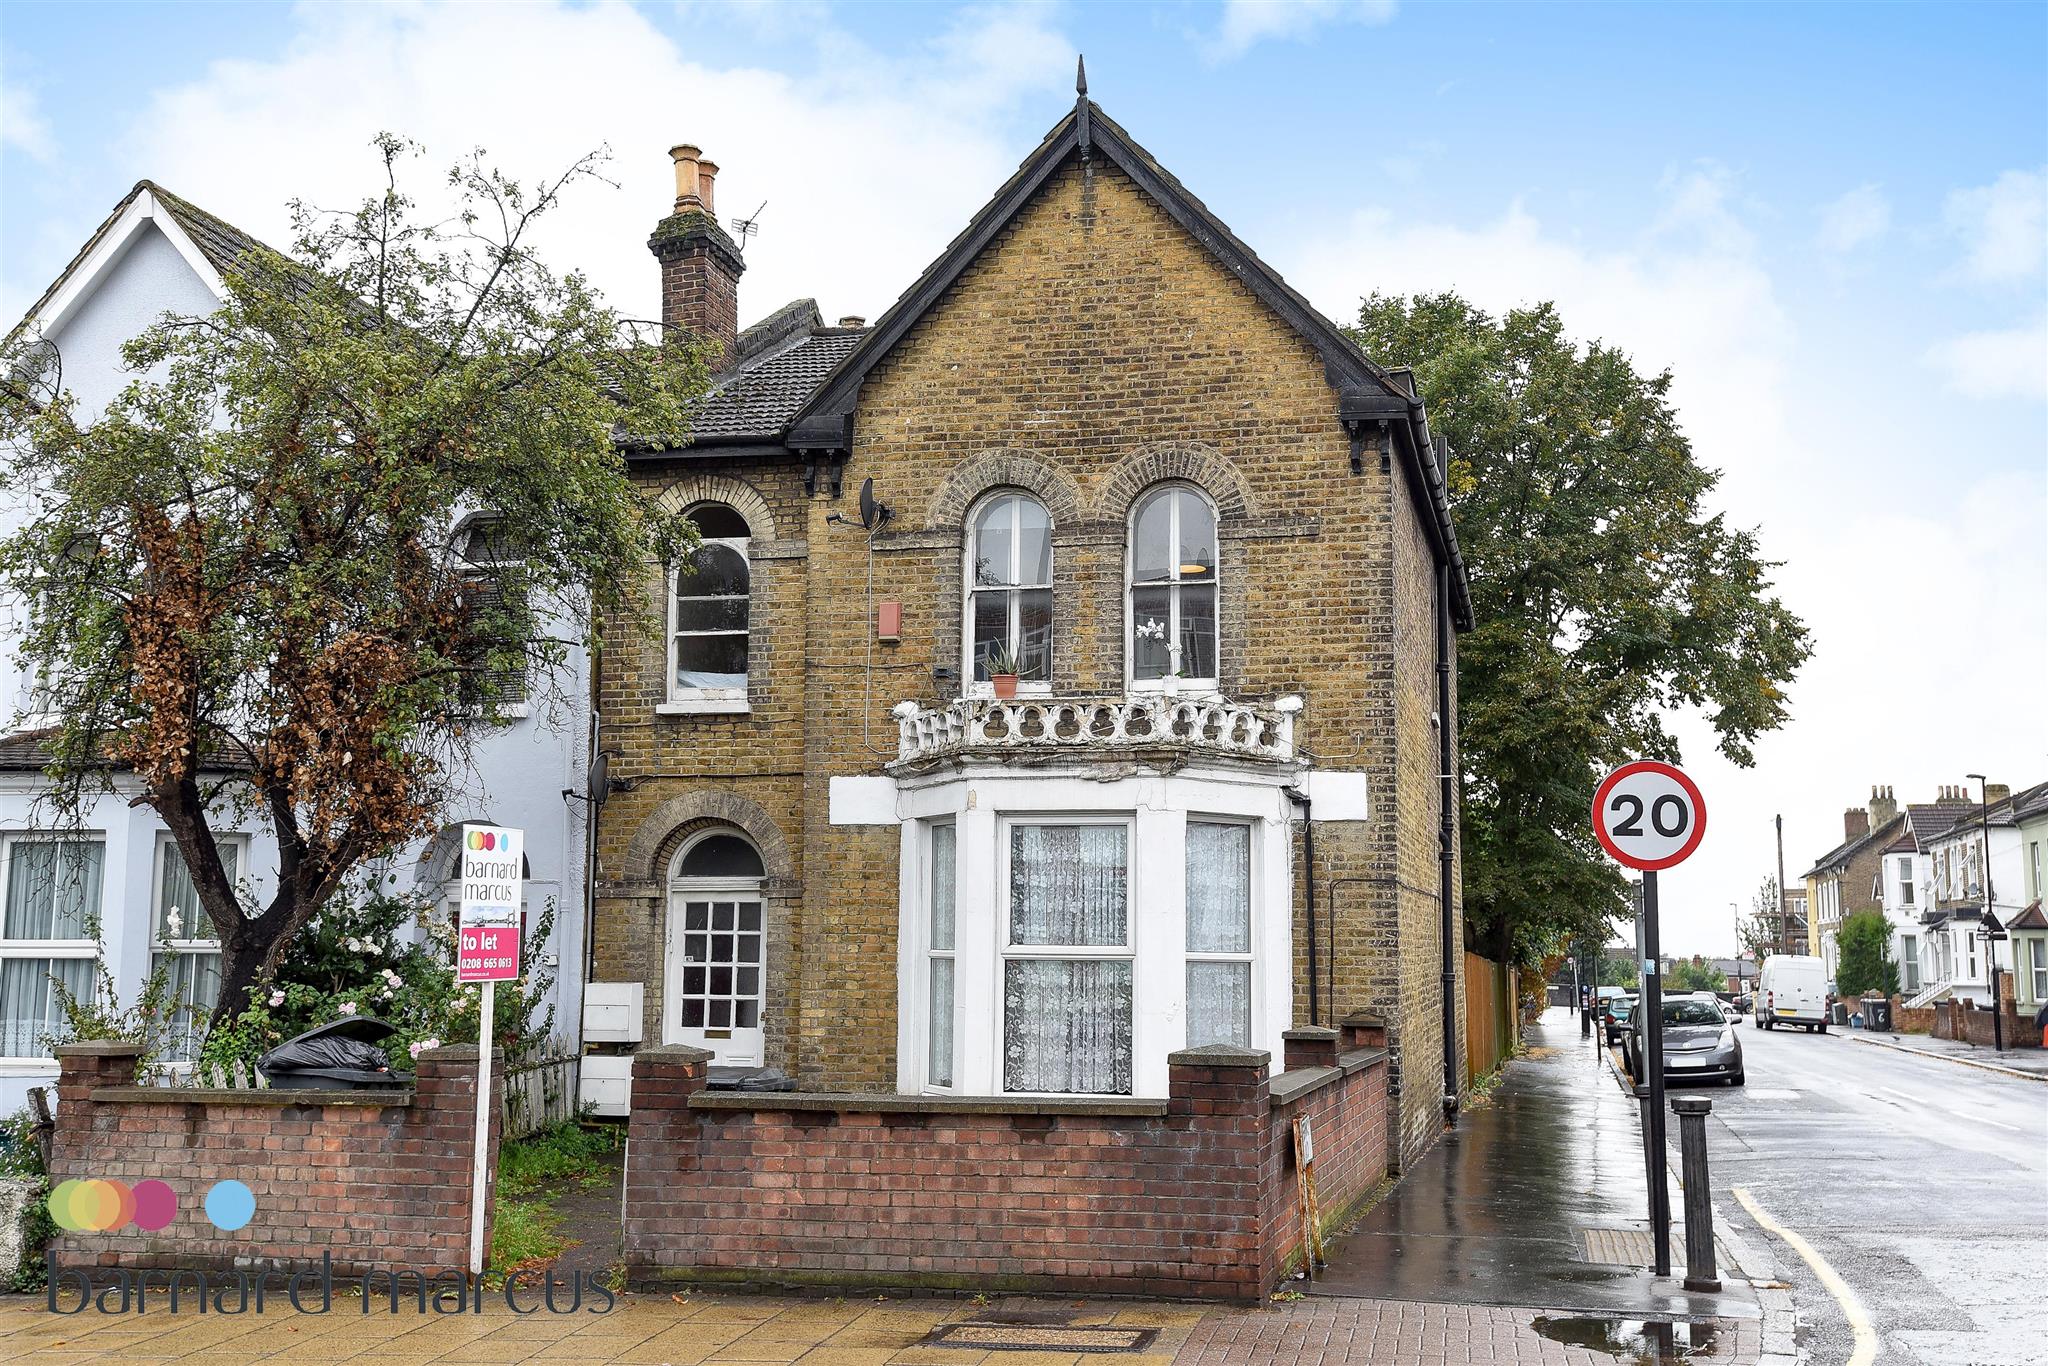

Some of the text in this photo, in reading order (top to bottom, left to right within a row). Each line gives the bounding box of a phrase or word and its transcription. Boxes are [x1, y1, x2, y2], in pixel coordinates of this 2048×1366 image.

[1611, 794, 1688, 837] 20
[465, 854, 517, 879] barnard
[465, 884, 512, 901] marcus
[462, 931, 498, 950] to let
[461, 958, 482, 969] 0208
[483, 958, 498, 969] 665
[1878, 1012, 1885, 1023] 6
